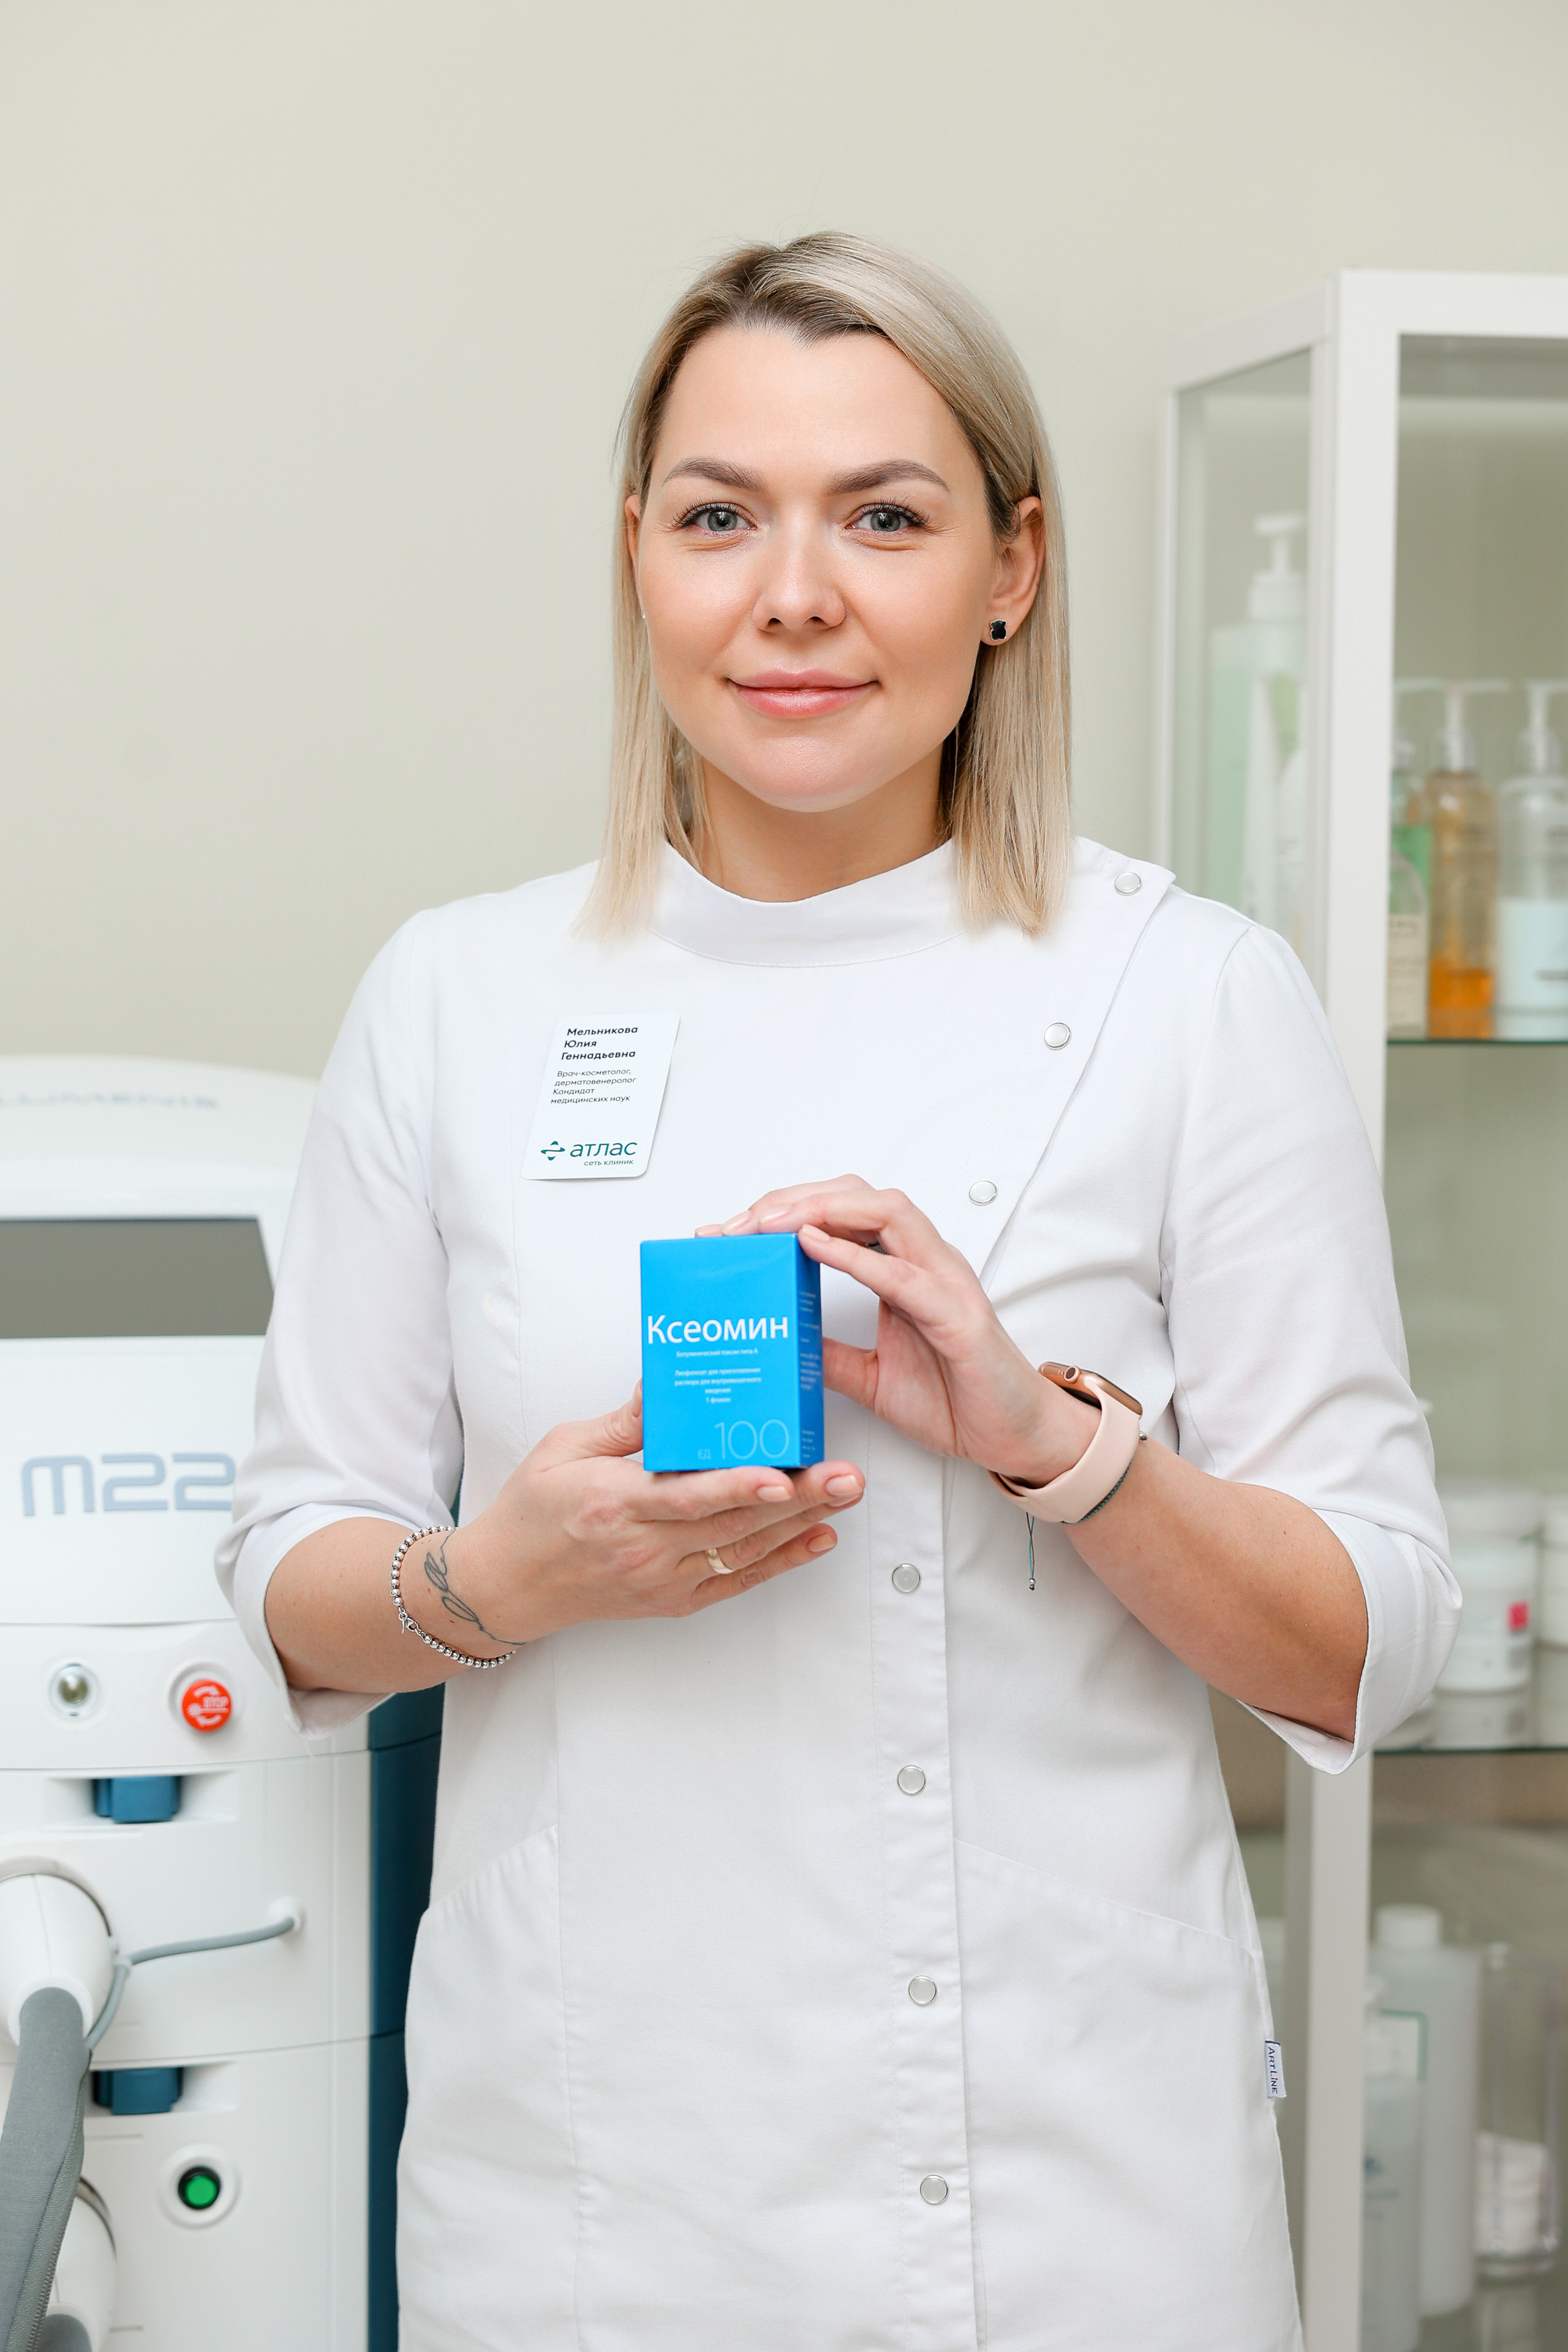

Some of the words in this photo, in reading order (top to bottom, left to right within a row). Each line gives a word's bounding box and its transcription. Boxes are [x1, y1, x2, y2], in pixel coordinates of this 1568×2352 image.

[567, 1027, 638, 1036] Мельникова
[561, 1051, 636, 1060] Геннадьевна
[557, 1069, 631, 1078] Врач-косметолог,
[554, 1078, 636, 1087] дерматовенеролог
[570, 1142, 638, 1157] атлас
[647, 1314, 788, 1344] Ксеомин
[714, 1419, 790, 1460] 100
